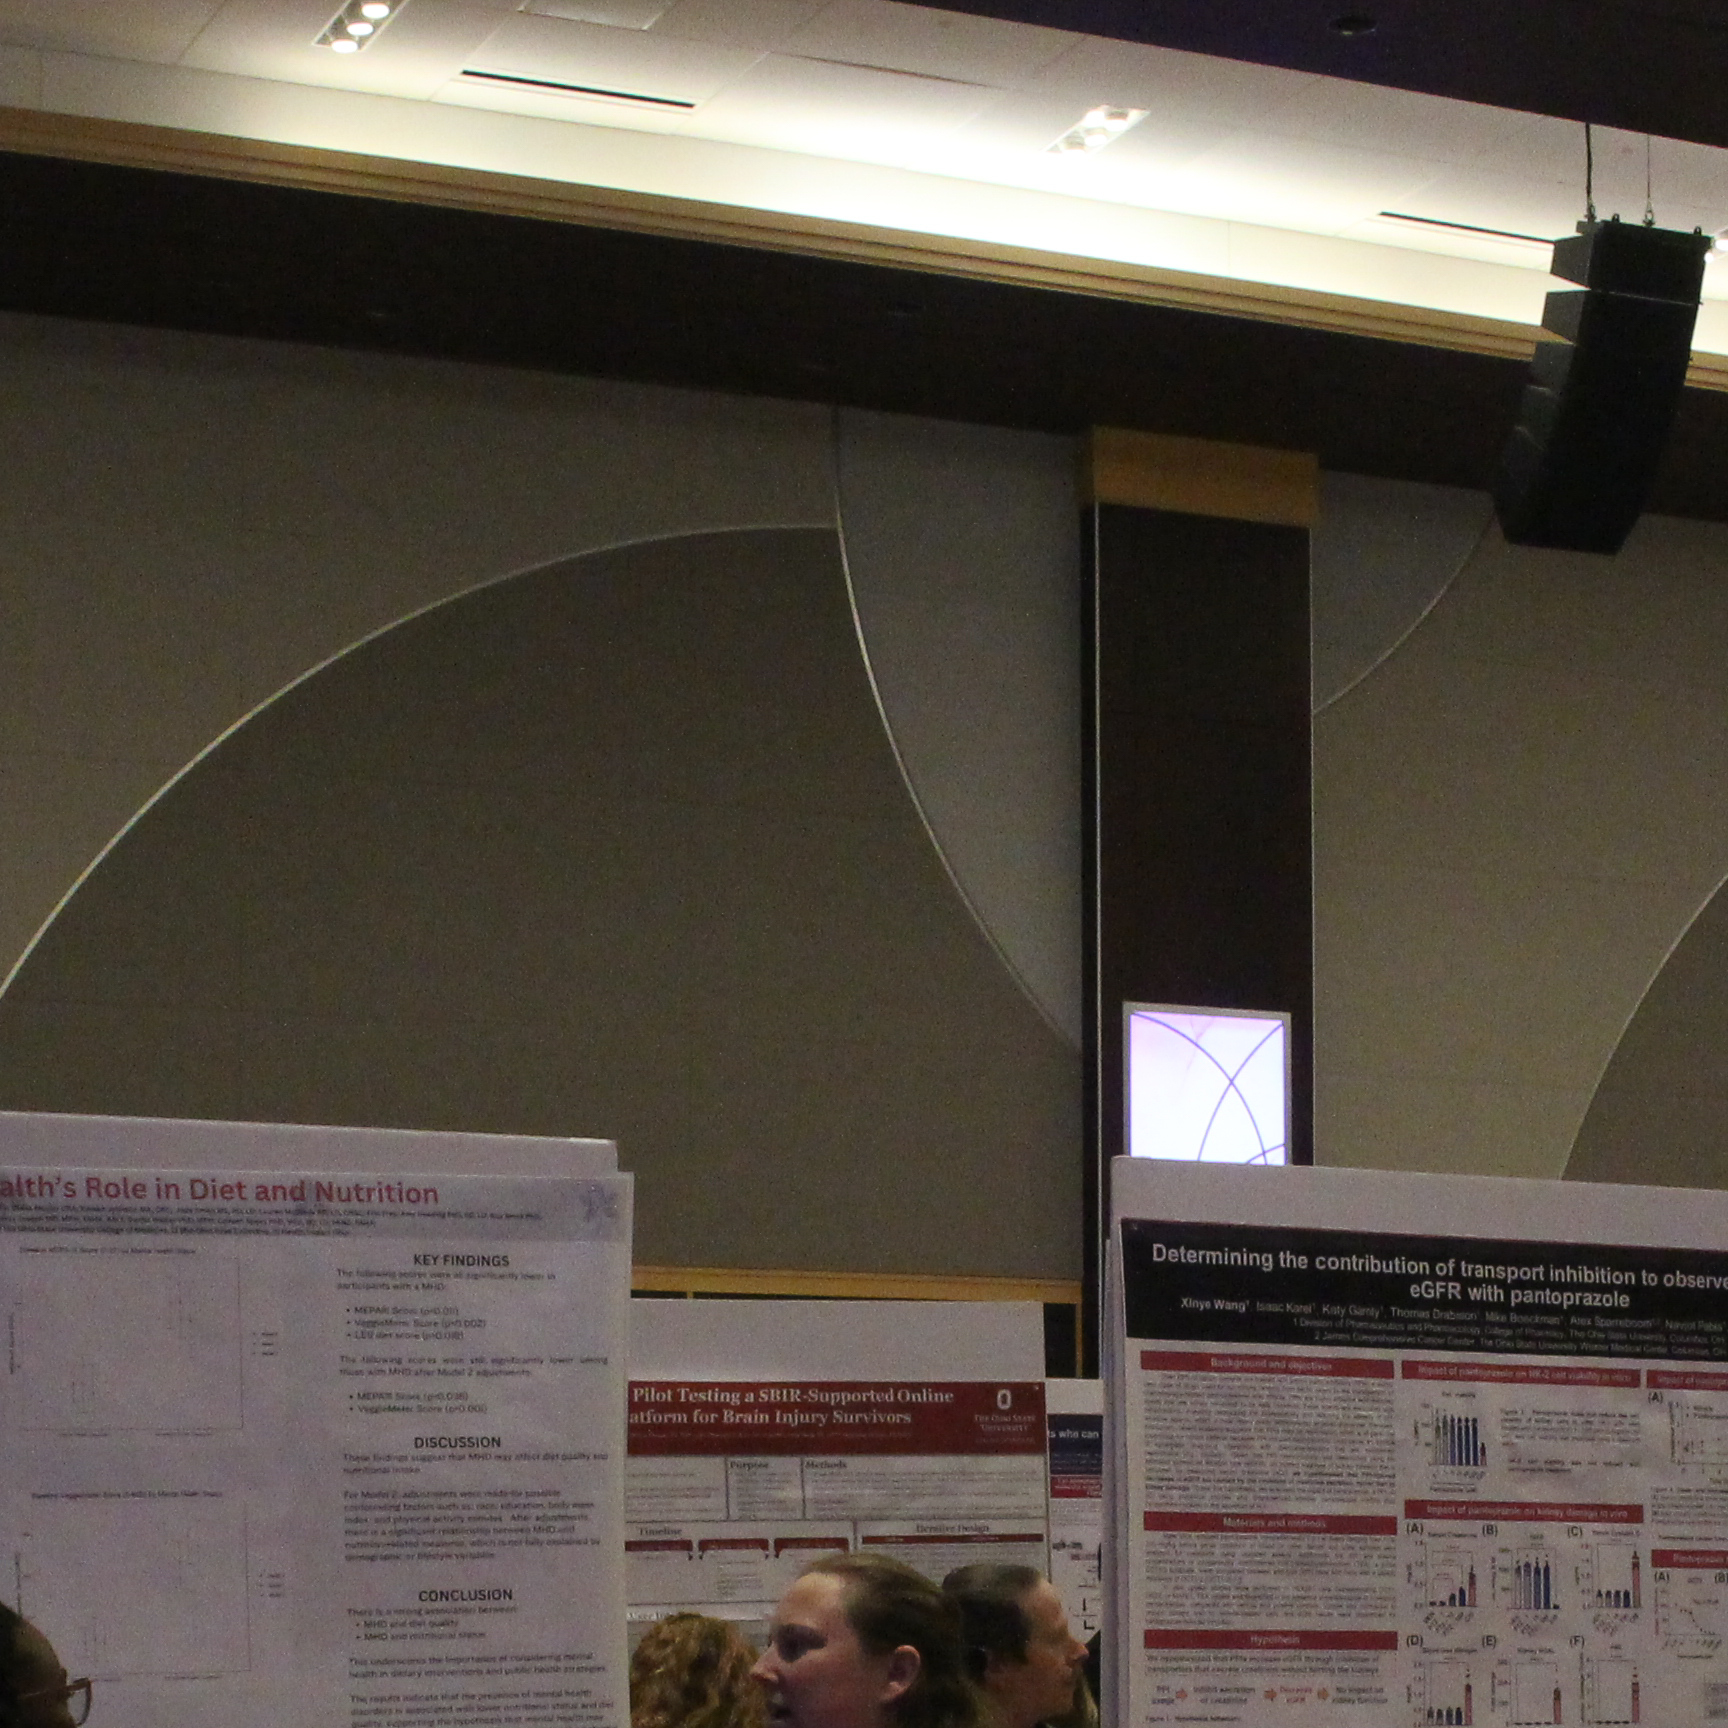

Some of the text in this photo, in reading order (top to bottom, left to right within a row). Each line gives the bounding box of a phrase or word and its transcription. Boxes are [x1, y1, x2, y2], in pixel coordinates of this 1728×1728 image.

[86, 1177, 147, 1199] Role
[155, 1178, 180, 1200] in
[190, 1178, 247, 1200] Diet
[255, 1180, 306, 1202] and
[315, 1181, 440, 1204] Nutrition
[413, 1254, 510, 1267] KEY FINDINGS
[1152, 1243, 1273, 1271] Determining
[1279, 1250, 1308, 1269] the
[1316, 1253, 1430, 1276] contribution
[1436, 1256, 1456, 1275] of
[1461, 1261, 1544, 1284] transport
[1550, 1265, 1635, 1285] inhibition
[1641, 1269, 1658, 1286] to
[1410, 1281, 1630, 1309] eGFR with pantoprazole
[633, 1387, 673, 1404] Pilot
[678, 1387, 740, 1407] Testing
[745, 1391, 755, 1404] a
[898, 1389, 954, 1403] Online
[630, 1409, 912, 1427] atform for Brain Injury Survivors
[414, 1437, 501, 1448] DISCUSSION
[419, 1589, 513, 1601] CONCLUSION
